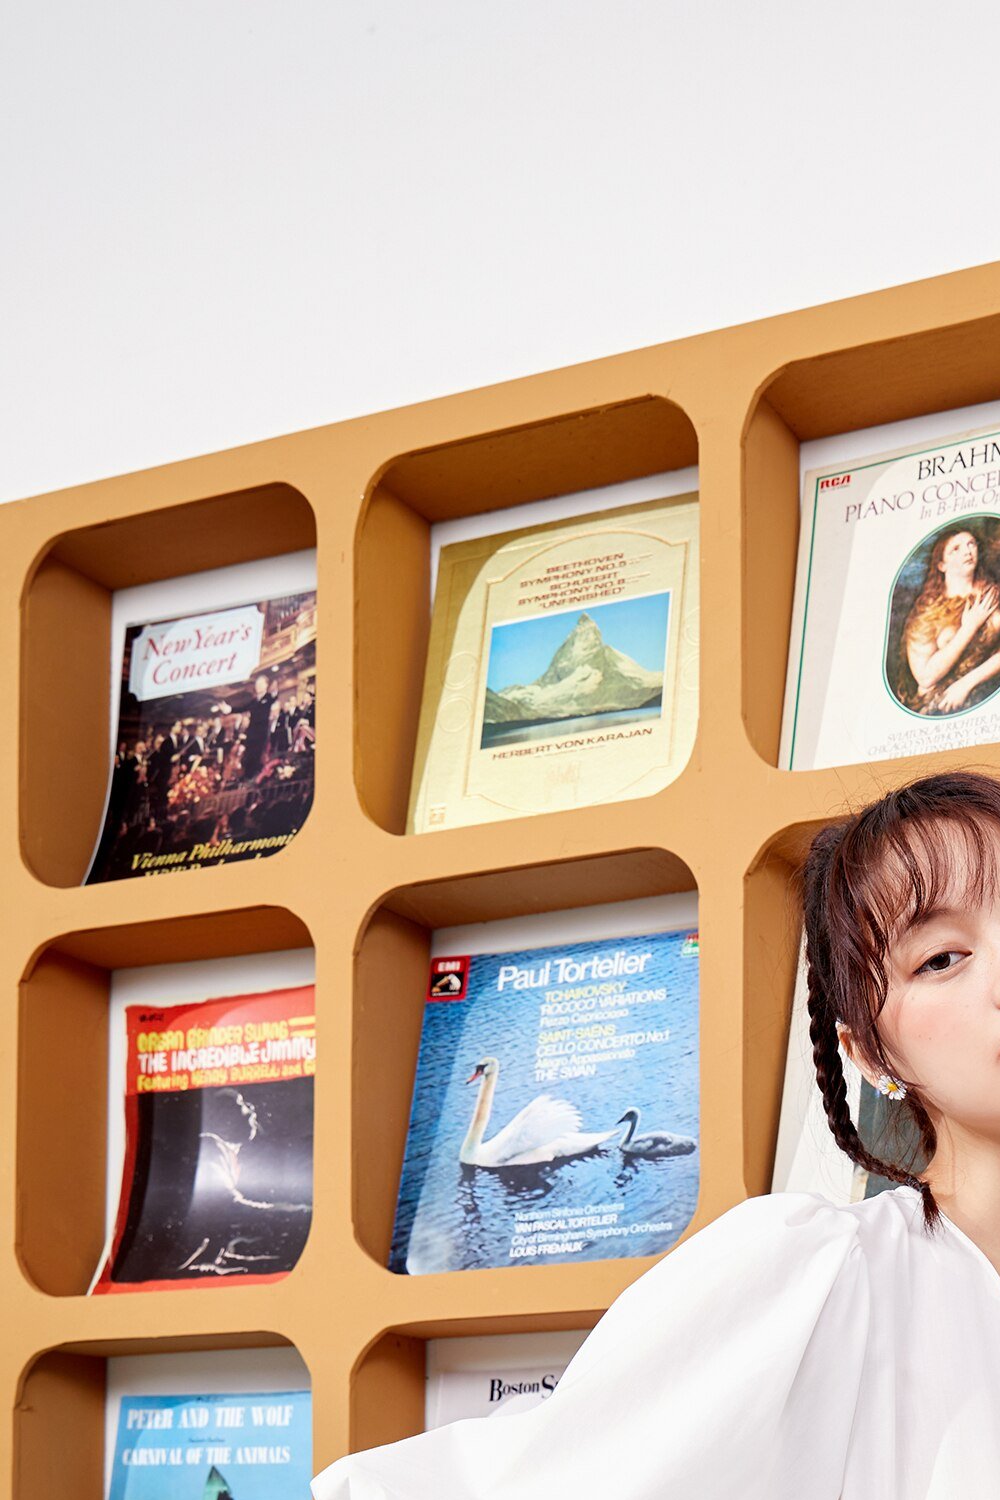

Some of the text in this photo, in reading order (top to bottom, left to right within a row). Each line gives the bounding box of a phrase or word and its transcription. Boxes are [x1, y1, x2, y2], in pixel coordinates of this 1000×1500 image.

[820, 475, 851, 489] RCA
[844, 490, 915, 524] PIANO
[546, 553, 624, 574] BEETHOVEN
[520, 567, 595, 588] SYMPHONY
[550, 572, 618, 591] SCHUBERT
[517, 586, 594, 606] SYMPHONY
[143, 624, 252, 661] New Year's
[153, 651, 238, 686] Concert
[492, 743, 553, 760] HERBERT
[555, 738, 585, 750] VON
[586, 728, 653, 745] KARAJAN
[131, 850, 188, 871] Vienna
[437, 960, 461, 972] EMI
[497, 951, 652, 992] Paul Tortelier
[540, 988, 667, 1016] ROCOCO VARIATIONS
[545, 980, 627, 1003] TCHAIKOVSKY
[536, 1041, 576, 1057] CELLO
[577, 1032, 645, 1051] CONCERTO
[137, 1052, 168, 1074] THE
[535, 1064, 596, 1081] THE SWAN
[137, 1073, 190, 1091] Featuring
[514, 1213, 618, 1233] YAN PASCAL TORTELIER
[586, 1225, 630, 1240] Symphony
[630, 1221, 673, 1234] Orchestra
[509, 1246, 537, 1258] LOUIS
[489, 1378, 540, 1402] Boston
[126, 1404, 294, 1430] PETER AND THE WOLF
[122, 1445, 291, 1466] CARNIVAL OF THE ANIMALS
